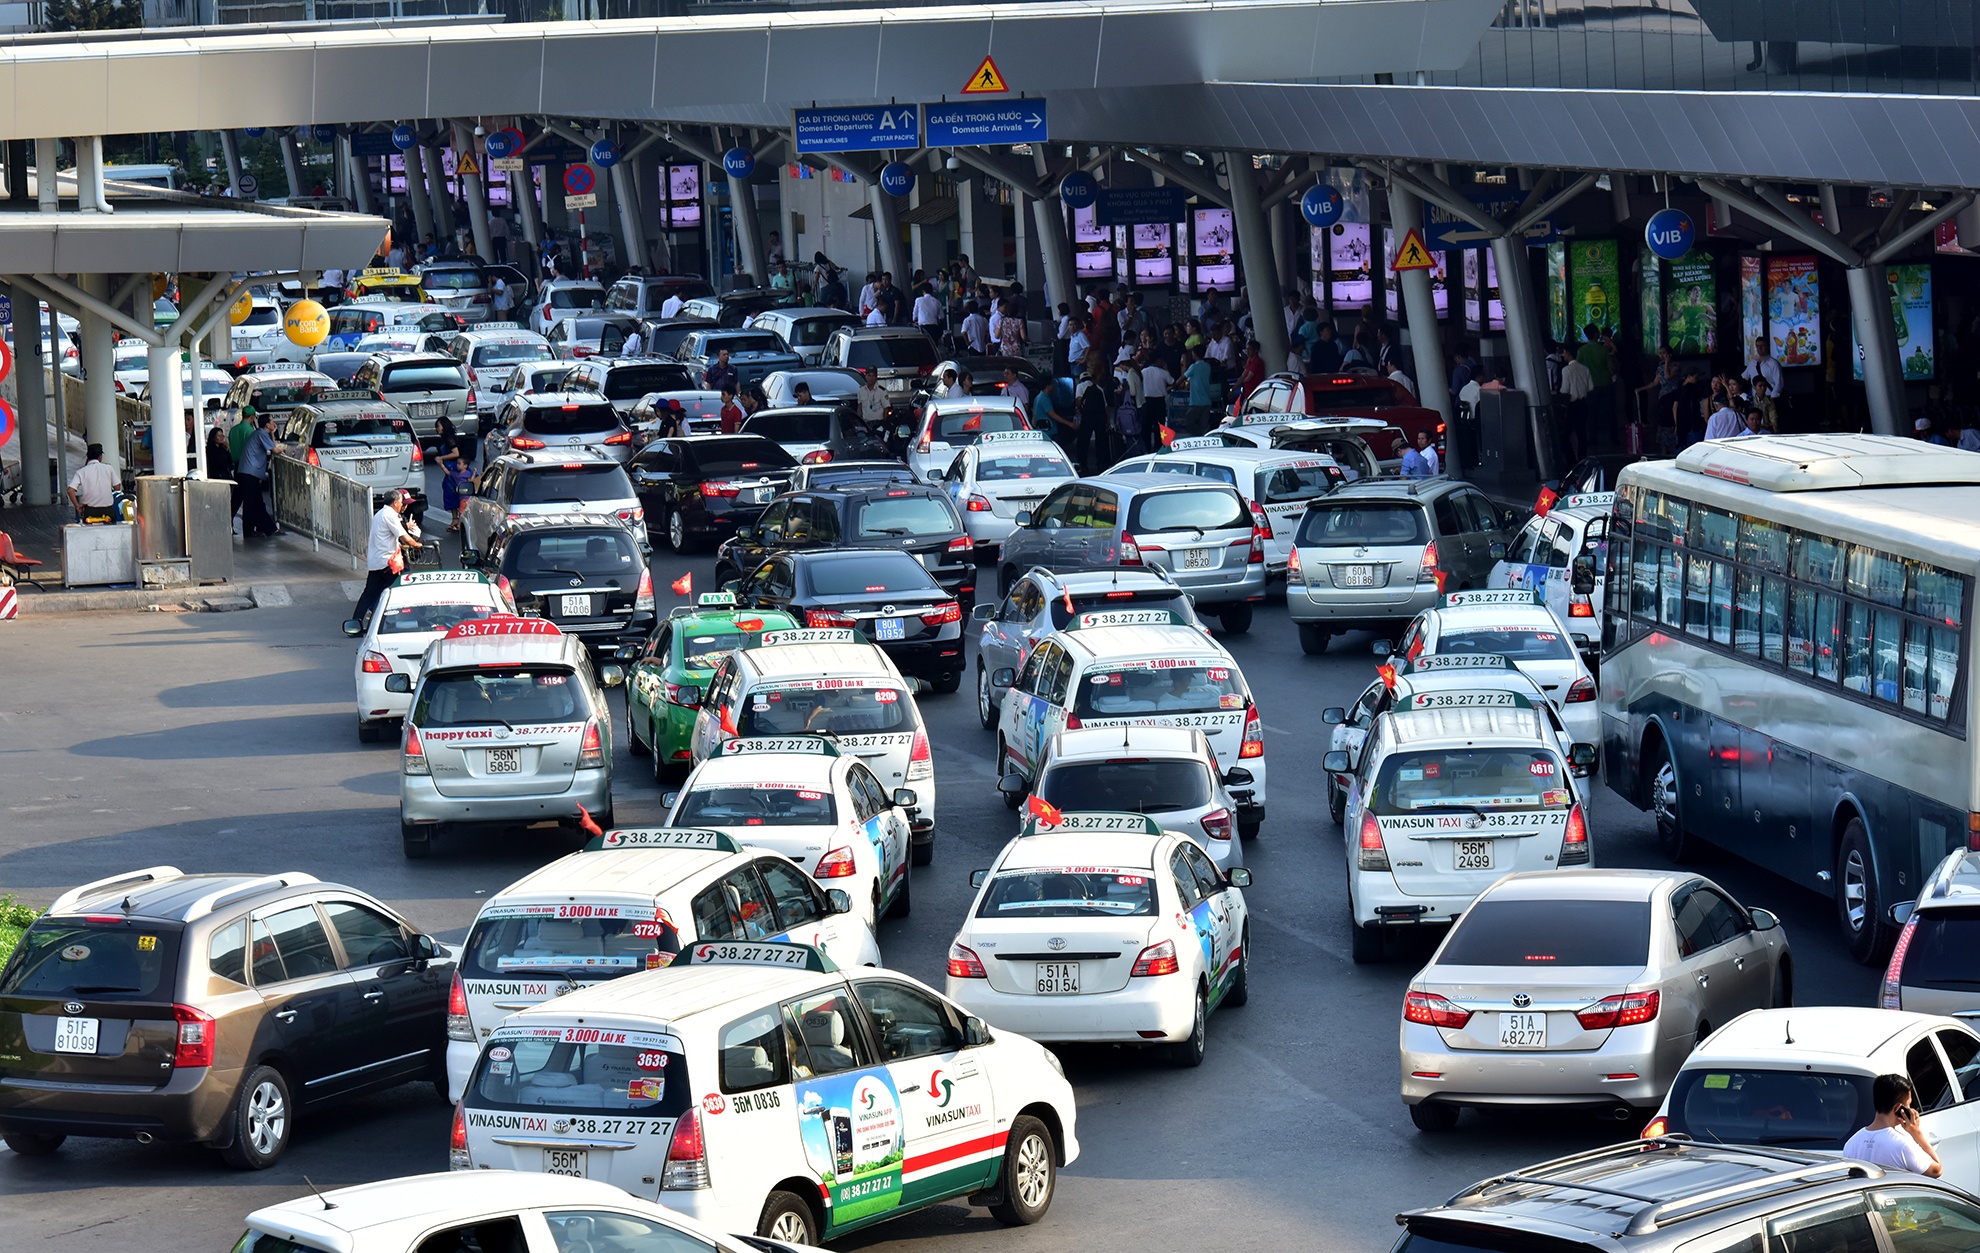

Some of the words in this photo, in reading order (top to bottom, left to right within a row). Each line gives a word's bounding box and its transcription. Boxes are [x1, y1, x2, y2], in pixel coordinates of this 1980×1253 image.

[854, 113, 874, 121] NƯỚC
[879, 110, 896, 130] A
[931, 116, 943, 124] GA
[945, 112, 963, 123] ĐẾN
[966, 114, 996, 122] TRONG
[997, 111, 1021, 121] NƯỚC
[799, 124, 832, 132] Domestic
[834, 123, 873, 132] Departures
[952, 125, 990, 134] Domestic
[991, 124, 1022, 133] Arrivals
[394, 134, 410, 143] VIB
[489, 141, 504, 150] VIB
[594, 151, 612, 160] VIB
[727, 160, 745, 169] VIB
[885, 176, 906, 185] VIB
[1065, 185, 1087, 196] VIB
[1307, 202, 1332, 216] VIB
[1652, 230, 1681, 245] VIB
[288, 319, 316, 327] PVcom
[299, 325, 319, 333] Bank
[1256, 414, 1278, 423] 38.27
[1183, 439, 1202, 448] 38.27
[1586, 495, 1613, 503] 38.27
[1189, 550, 1203, 559] 51F
[1185, 558, 1209, 568] 085.20
[1352, 567, 1367, 576] 60A
[419, 573, 447, 582] 38.27
[569, 597, 584, 605] 51A
[703, 594, 734, 603] TAXI
[1468, 594, 1499, 602] 38.27
[1502, 593, 1514, 602] 27
[1518, 593, 1531, 601] 27
[564, 605, 589, 614] 740.06
[1102, 613, 1134, 623] 38.27
[1138, 614, 1151, 622] 27
[1155, 612, 1168, 621] 27
[458, 623, 498, 636] 38.77
[505, 623, 523, 634] 77
[529, 621, 548, 632] 77
[882, 620, 897, 630] 80A
[782, 631, 815, 642] 38.27
[819, 631, 833, 641] 27
[836, 630, 851, 640] 27
[877, 629, 904, 639] 019.52
[1150, 660, 1176, 668] 3.000
[1435, 657, 1468, 666] 38.27
[1472, 657, 1485, 666] 27
[1489, 656, 1503, 665] 27
[1209, 669, 1229, 679] 7103
[816, 680, 843, 689] 3.000
[1437, 696, 1474, 705] 38.27
[1478, 696, 1492, 705] 27
[1498, 695, 1513, 704] 27
[1175, 717, 1207, 727] 38.27
[1212, 716, 1225, 725] 27
[1229, 715, 1242, 724] 27
[425, 731, 464, 741] happy
[466, 728, 493, 739] taxi
[515, 726, 581, 735] 38.77.77.77
[747, 740, 783, 750] 38.27
[787, 740, 802, 750] 27
[806, 740, 822, 750] 27
[843, 737, 876, 747] 38.27
[494, 750, 514, 760] 56N
[490, 762, 517, 772] 5850
[1530, 761, 1555, 774] 4610
[800, 792, 822, 800] 5553
[1062, 818, 1102, 828] 38.27
[1106, 818, 1122, 828] 27
[1127, 818, 1144, 828] 27
[1381, 817, 1435, 829] VINASUN
[1437, 817, 1461, 827] TAXI
[1488, 814, 1527, 826] 38.27
[1531, 814, 1547, 825] 27
[1551, 813, 1567, 824] 27
[629, 832, 671, 844] 38.27
[674, 833, 692, 844] 27
[696, 833, 714, 844] 27
[1462, 842, 1486, 855] 56M
[1458, 855, 1490, 868] 2499
[559, 906, 592, 918] 3.000
[594, 907, 608, 917] LÁI
[608, 908, 618, 917] XE
[634, 924, 661, 936] 3724
[718, 946, 759, 962] 38.27
[763, 948, 782, 963] 27
[787, 950, 805, 964] 27
[1046, 965, 1069, 978] 51A
[466, 984, 520, 995] VINASUN
[523, 984, 547, 994] TAXI
[1037, 978, 1078, 992] 691.54
[67, 1004, 80, 1012] KIA
[66, 1020, 88, 1035] 51F
[1510, 1015, 1534, 1030] 51A
[565, 1028, 599, 1043] 3.000
[601, 1032, 615, 1043] LÁI
[615, 1034, 627, 1043] XE
[1501, 1030, 1544, 1046] 482.77
[57, 1034, 95, 1050] 810.99
[637, 1052, 668, 1067] 3638
[703, 1097, 724, 1112] 3638
[733, 1097, 753, 1114] 56M
[754, 1091, 781, 1109] 0836
[858, 1110, 883, 1122] VINASUN
[576, 1119, 621, 1134] 38.27
[625, 1120, 647, 1135] 27
[650, 1121, 671, 1136] 27
[552, 1152, 578, 1169] 56M
[851, 1185, 861, 1198] 38
[862, 1181, 871, 1195] 27
[872, 1179, 881, 1192] 27
[882, 1176, 892, 1189] 27
